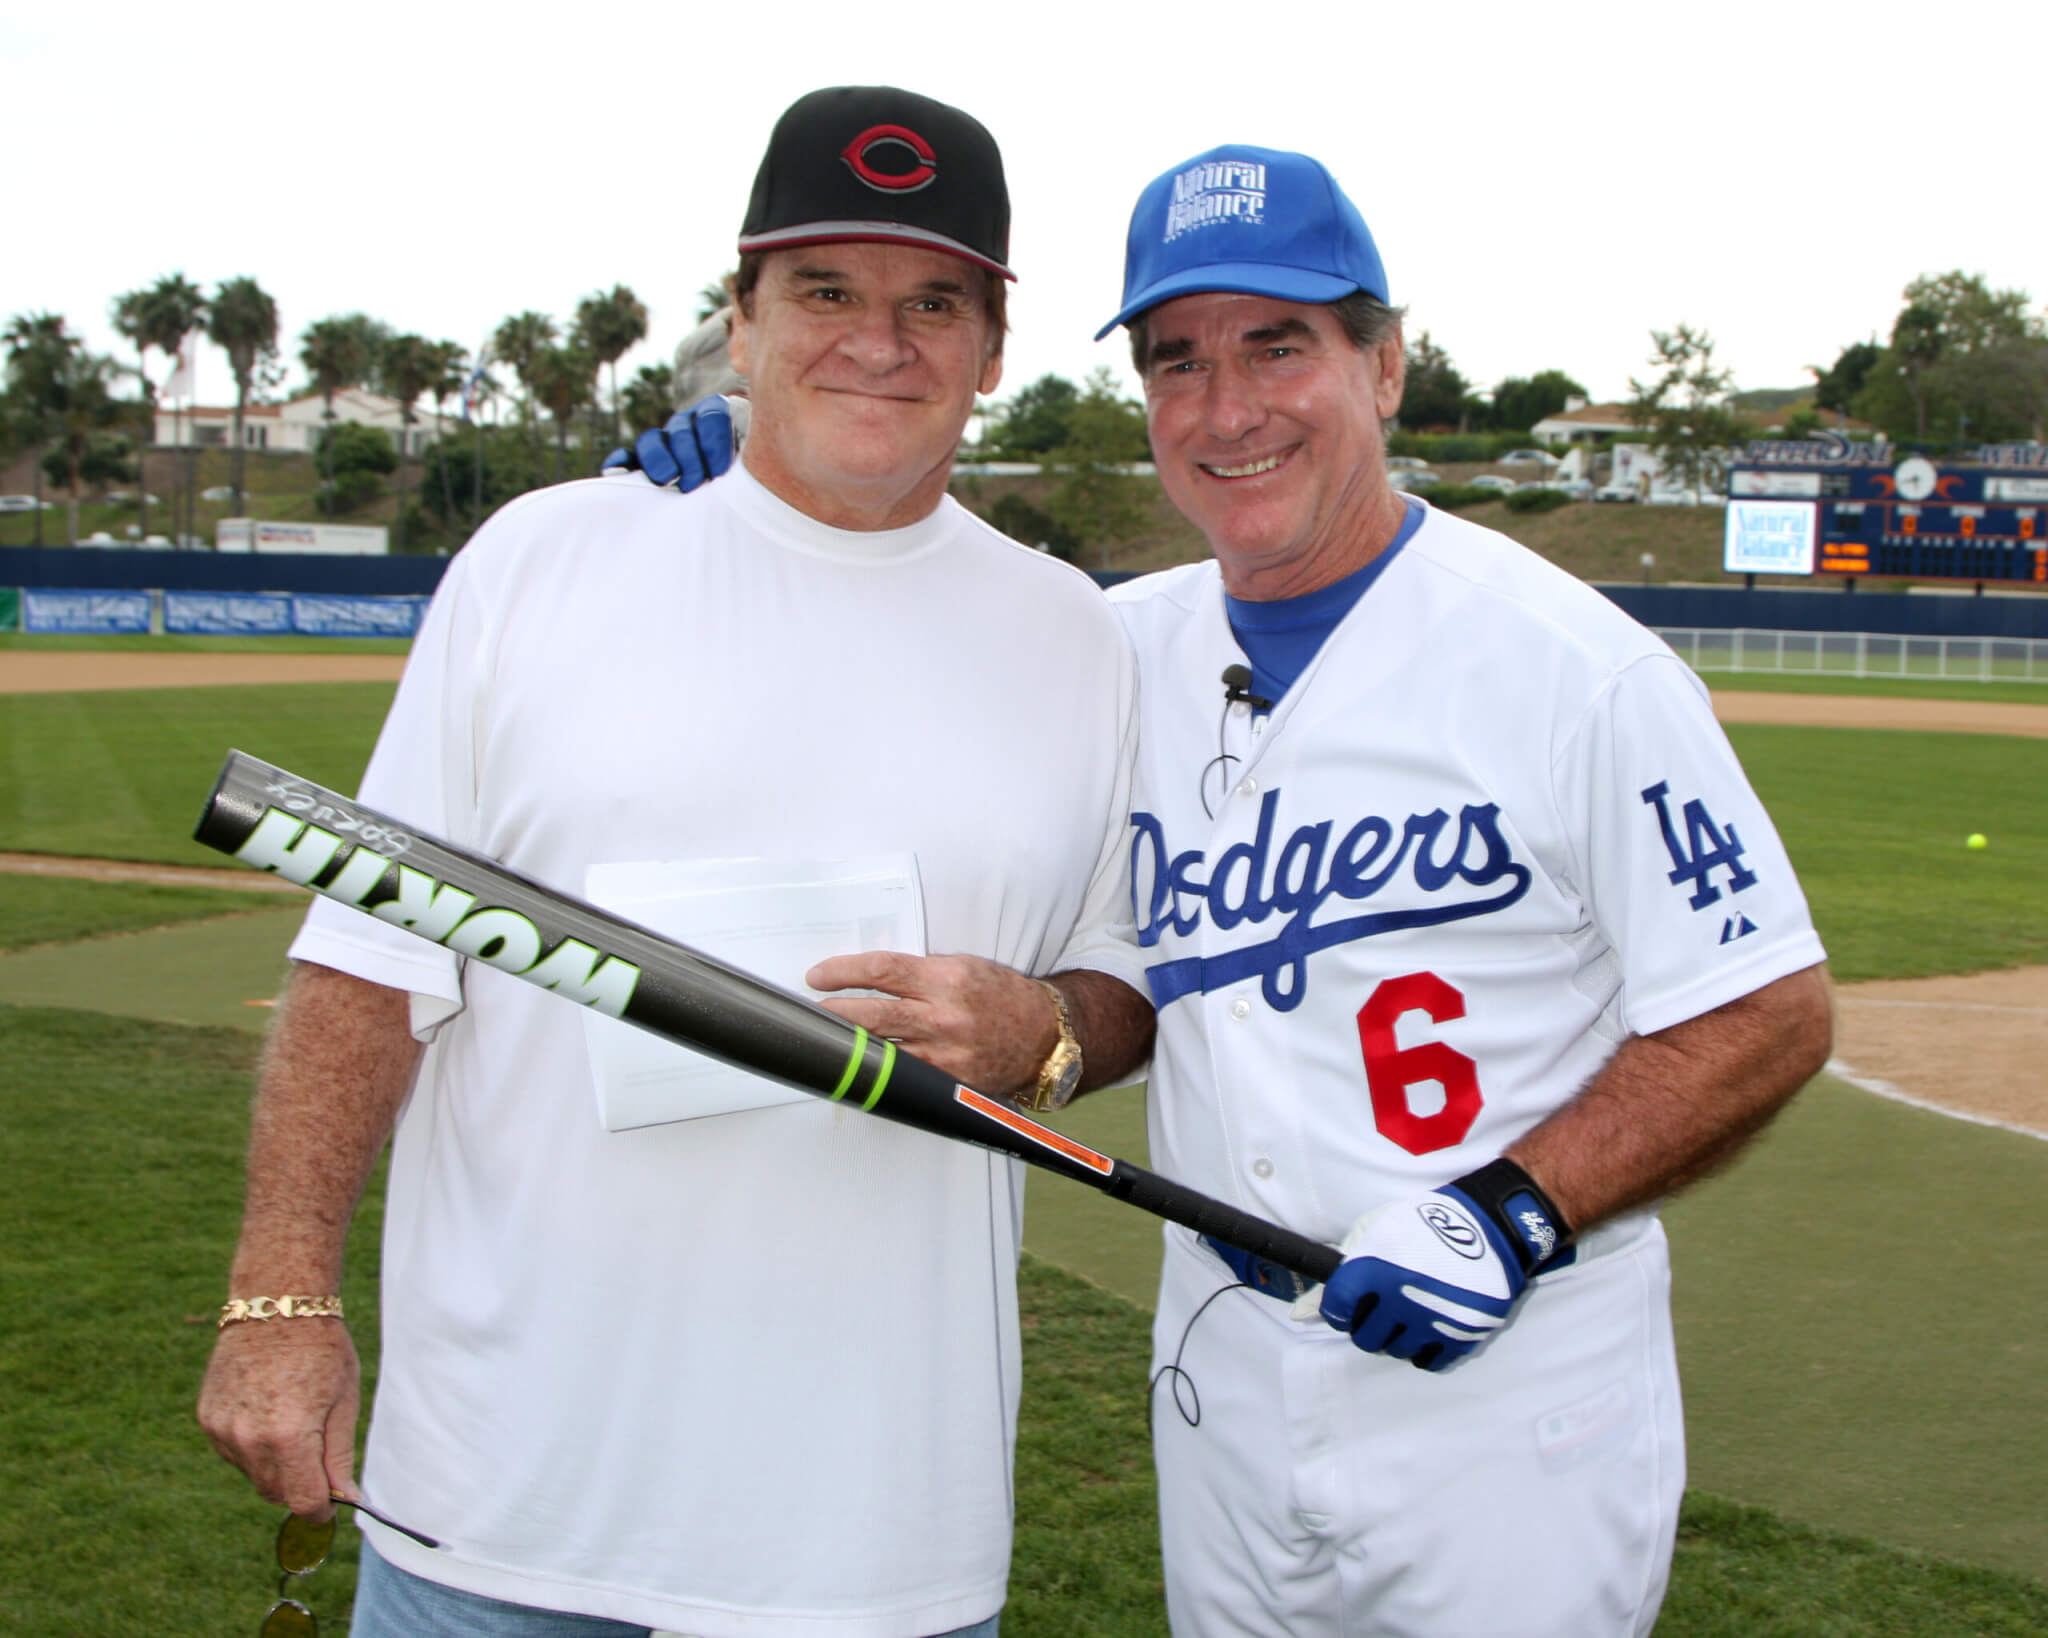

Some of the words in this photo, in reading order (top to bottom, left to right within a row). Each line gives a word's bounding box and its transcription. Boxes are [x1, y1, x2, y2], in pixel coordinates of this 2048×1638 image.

[841, 124, 938, 194] C
[234, 805, 642, 1019] WORTH
[1130, 787, 1532, 1012] Dodgers
[1641, 779, 1759, 912] LA
[1356, 971, 1485, 1156] 6
